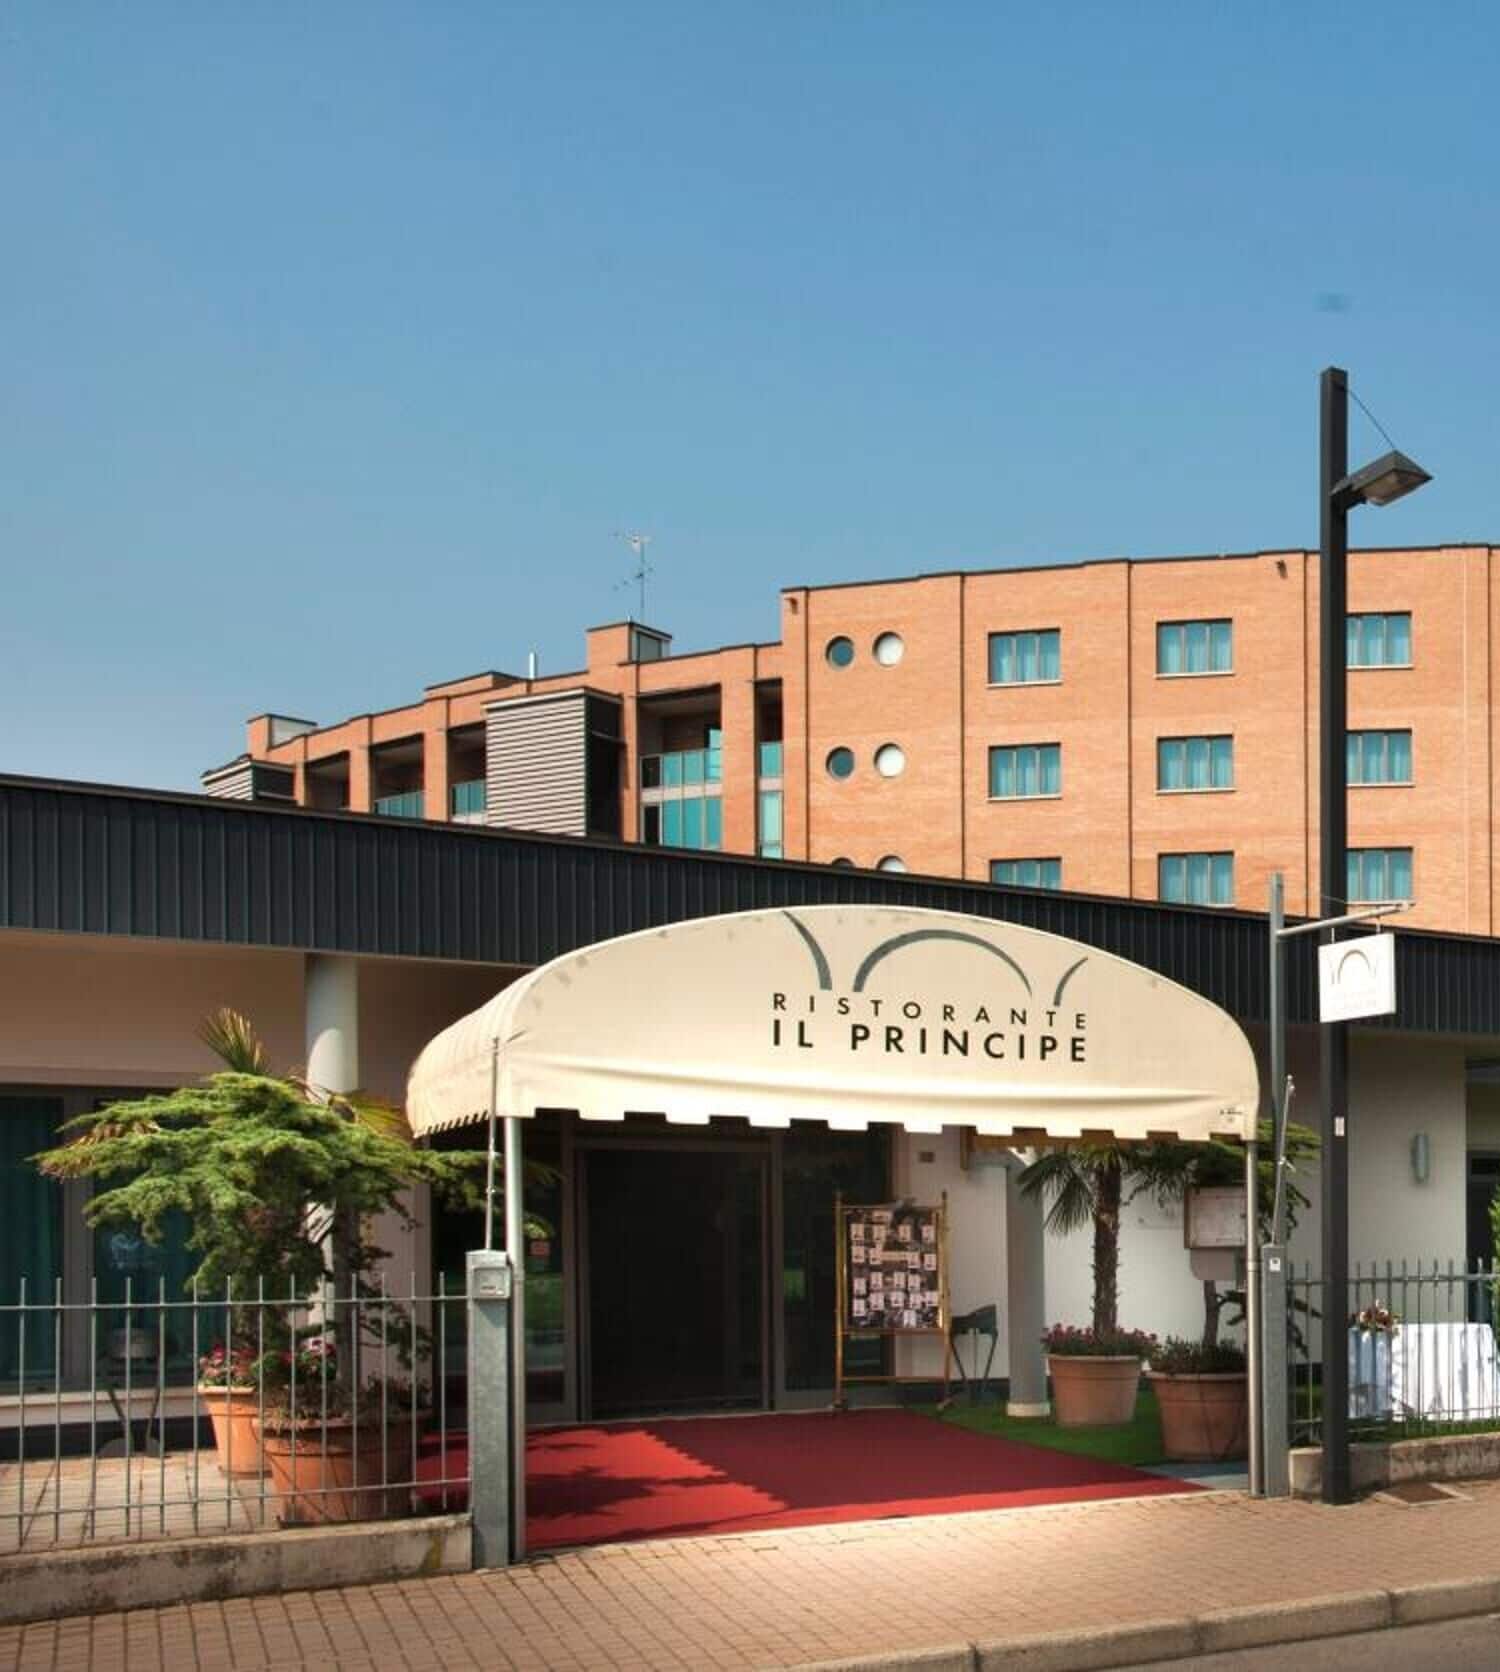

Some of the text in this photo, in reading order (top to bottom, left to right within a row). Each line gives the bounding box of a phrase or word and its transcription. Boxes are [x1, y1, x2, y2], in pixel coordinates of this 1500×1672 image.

[773, 993, 1087, 1029] RISTORANTE
[773, 1018, 1087, 1063] IL PRINCIPE
